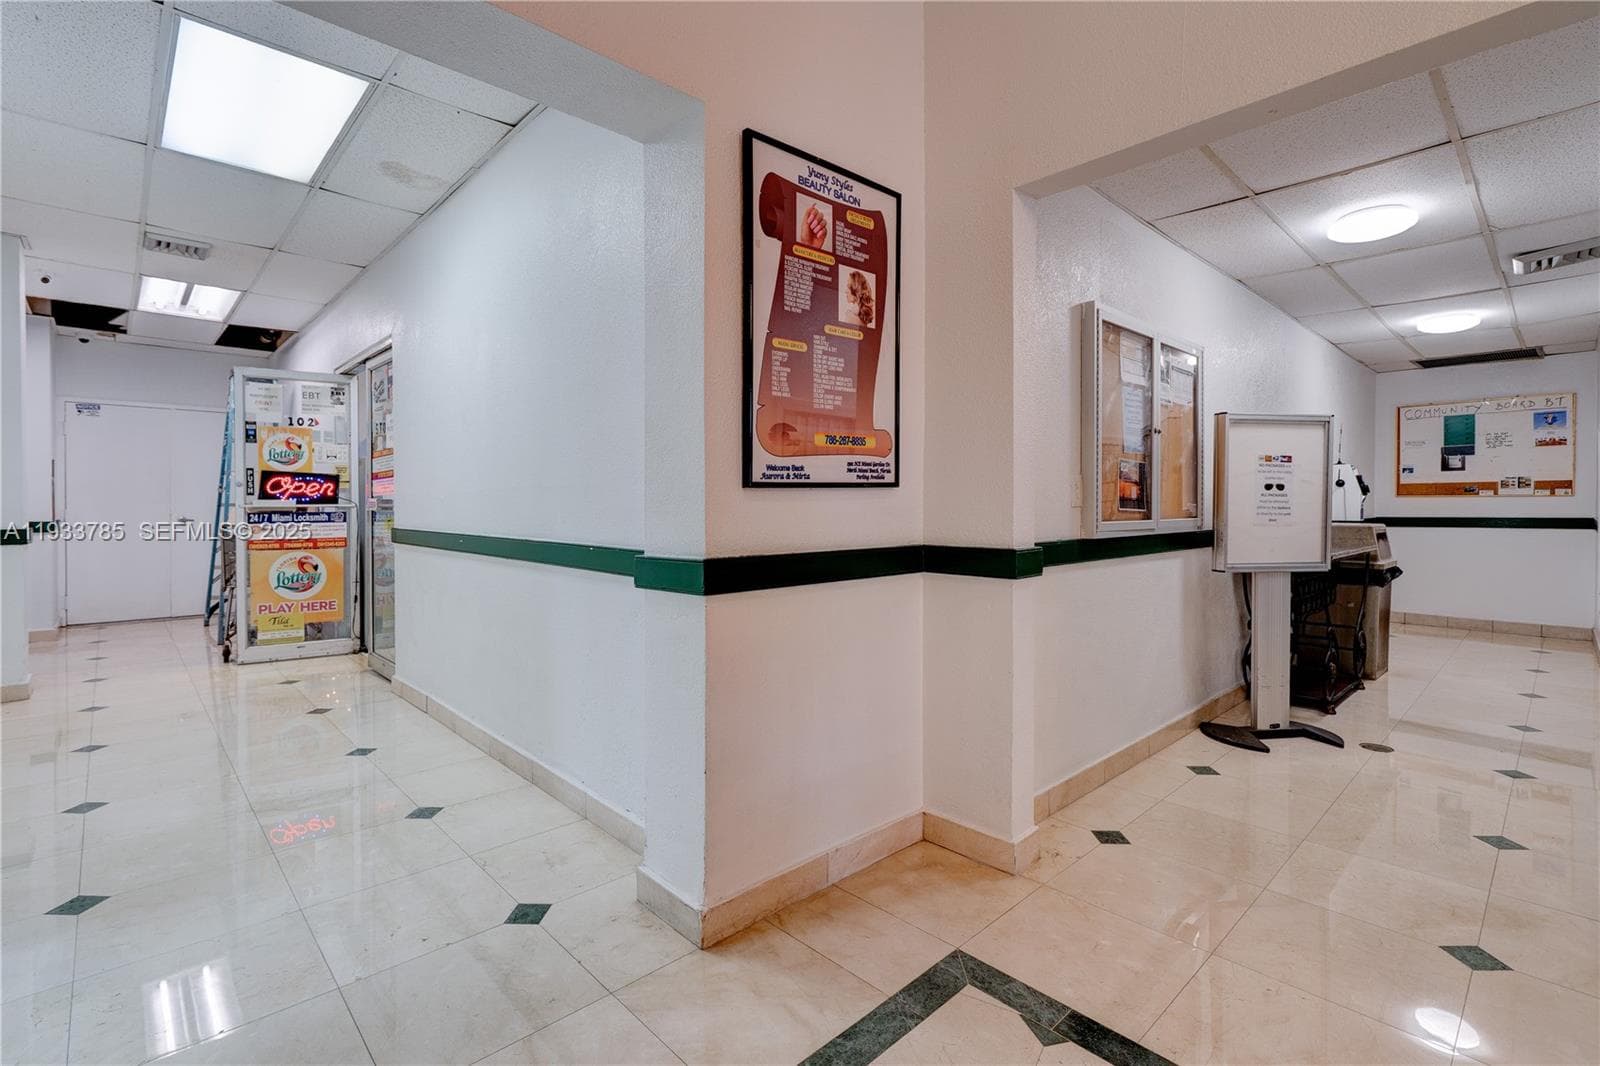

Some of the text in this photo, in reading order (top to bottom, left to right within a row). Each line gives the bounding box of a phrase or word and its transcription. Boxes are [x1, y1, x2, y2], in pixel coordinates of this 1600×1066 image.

[798, 175, 861, 207] BEAUTY SALON
[302, 391, 320, 400] EBT
[1404, 403, 1483, 420] COMMUNITY
[1496, 399, 1536, 410] BOARD
[267, 447, 304, 462] Lottery
[791, 464, 805, 472] Back
[785, 472, 791, 480] &
[266, 477, 335, 501] Open
[272, 513, 292, 522] Miami
[294, 513, 328, 522] Locksmith
[274, 570, 322, 591] Lottery
[258, 600, 337, 615] PLAY HERE
